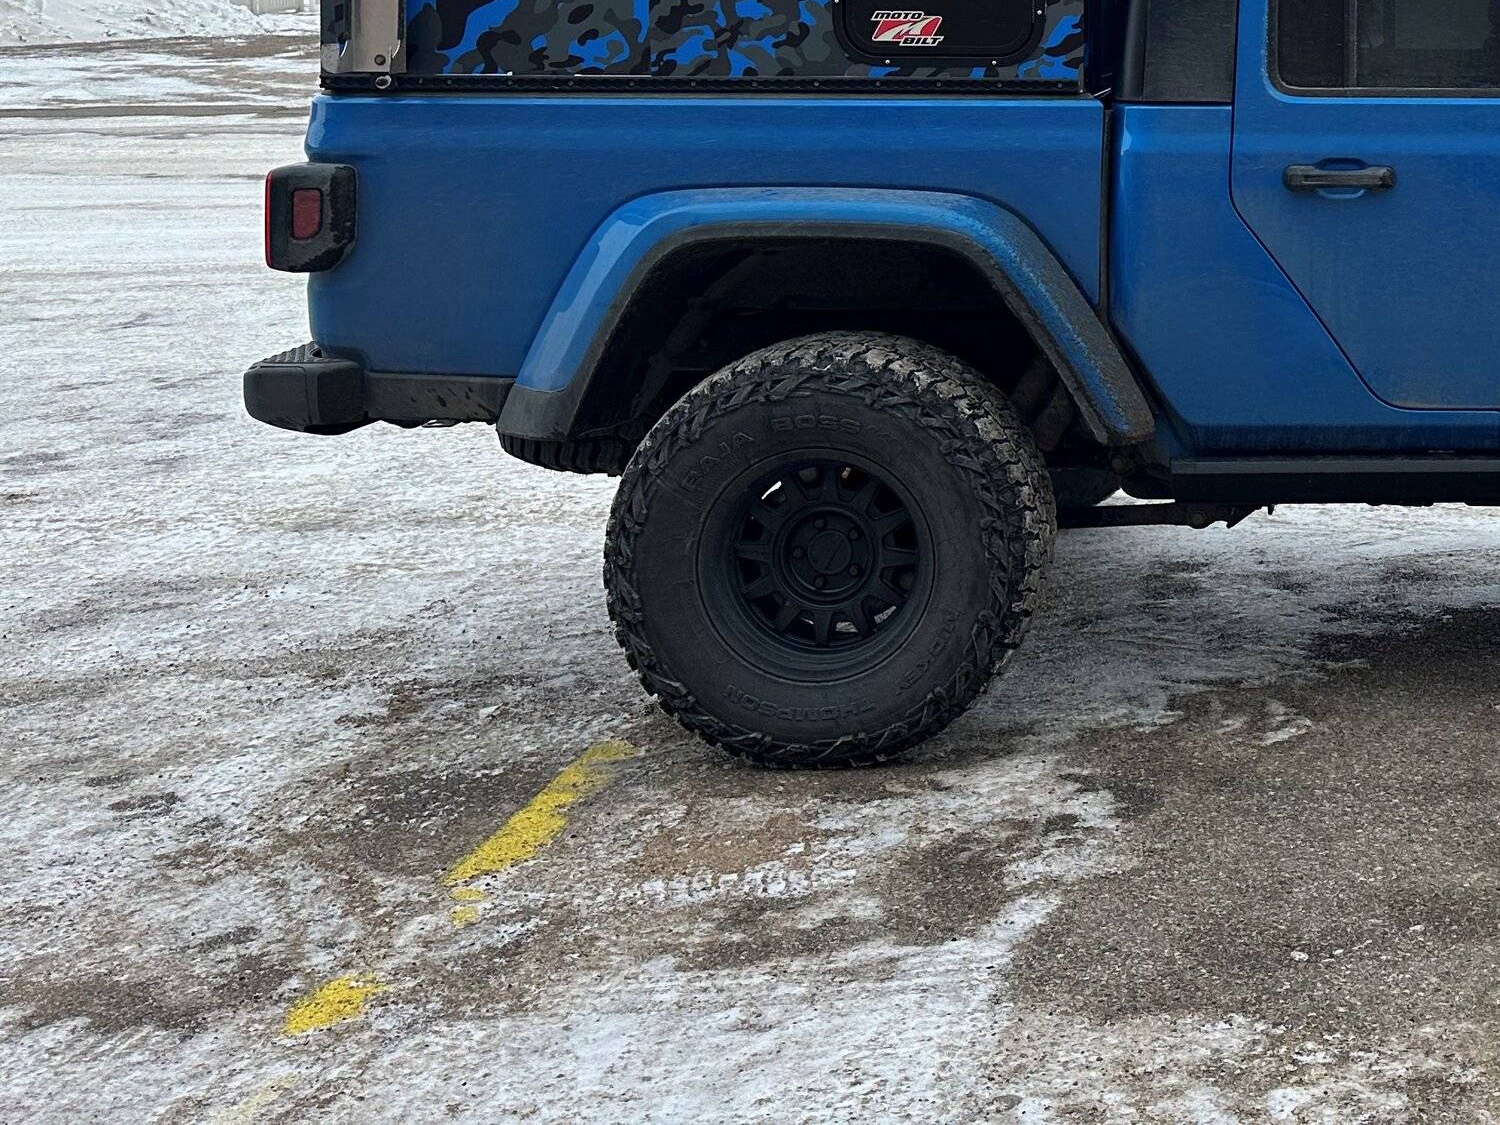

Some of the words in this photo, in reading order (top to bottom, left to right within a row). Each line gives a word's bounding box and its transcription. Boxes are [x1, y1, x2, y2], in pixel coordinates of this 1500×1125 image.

[872, 11, 923, 20] MOTO
[901, 36, 943, 45] BILT
[681, 431, 756, 491] BAJA
[771, 414, 862, 434] BOSS
[722, 685, 876, 721] THOMPSON
